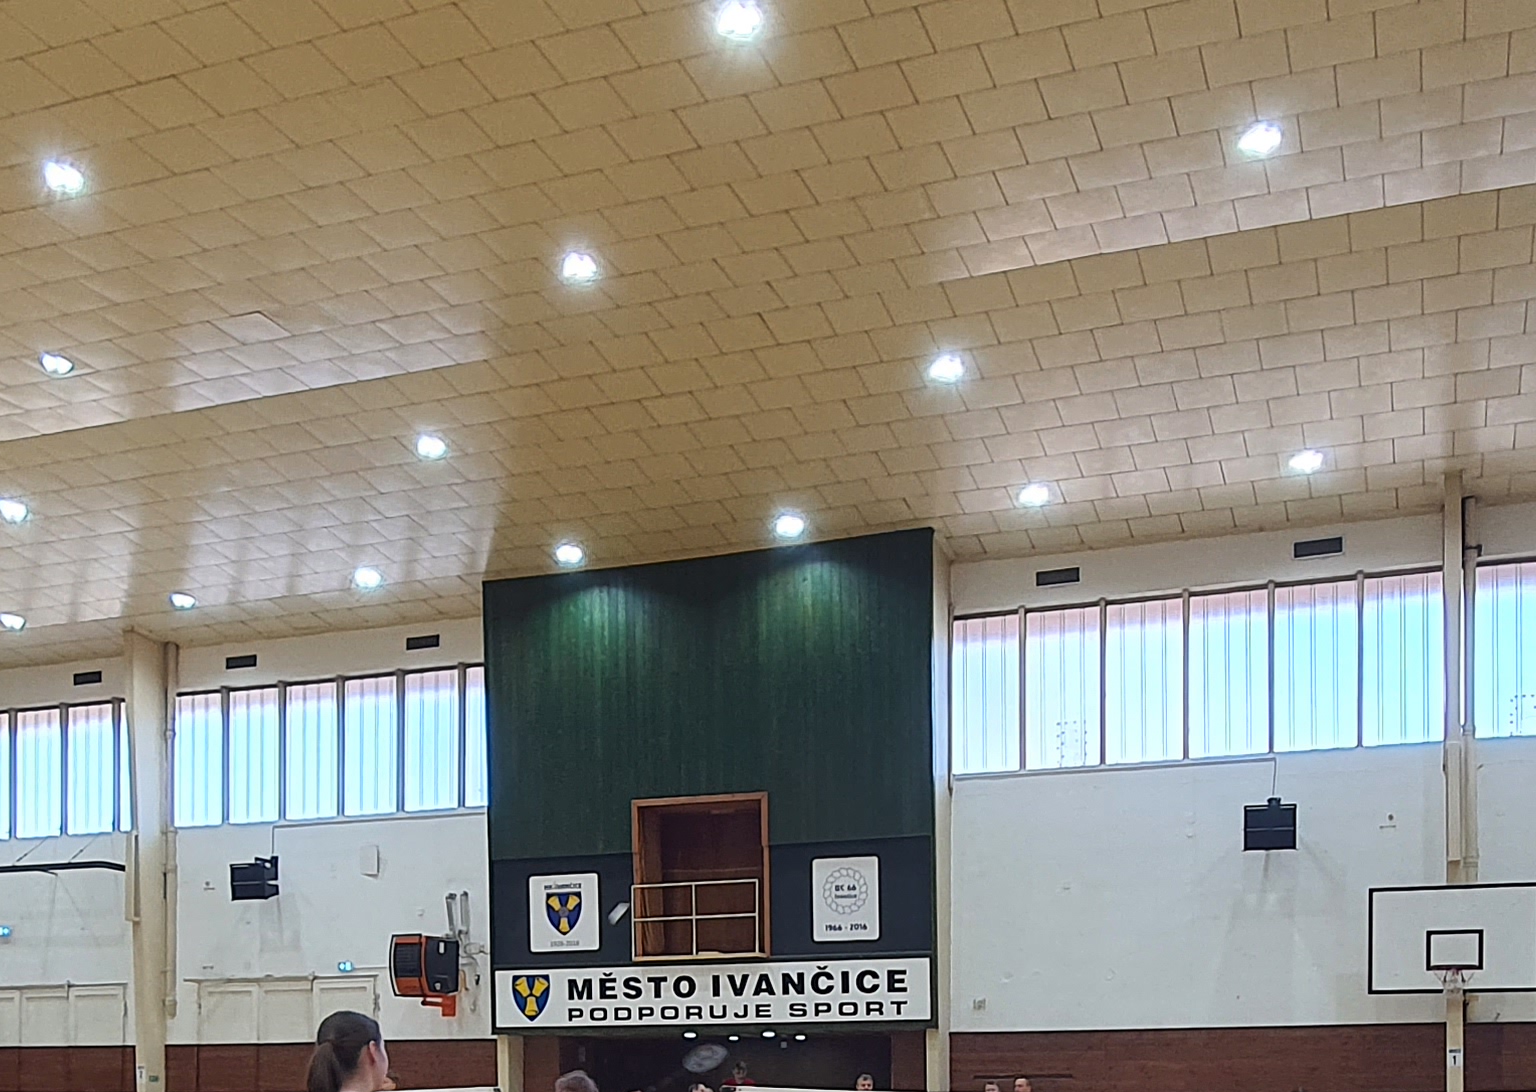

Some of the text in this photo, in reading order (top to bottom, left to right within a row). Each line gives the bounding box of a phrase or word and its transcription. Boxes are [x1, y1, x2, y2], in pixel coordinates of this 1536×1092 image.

[825, 924, 843, 932] 1966
[850, 922, 868, 931] 2016
[567, 965, 908, 1000] MĚSTO IVANČICE
[567, 1000, 908, 1022] PODPORUJE SPORT
